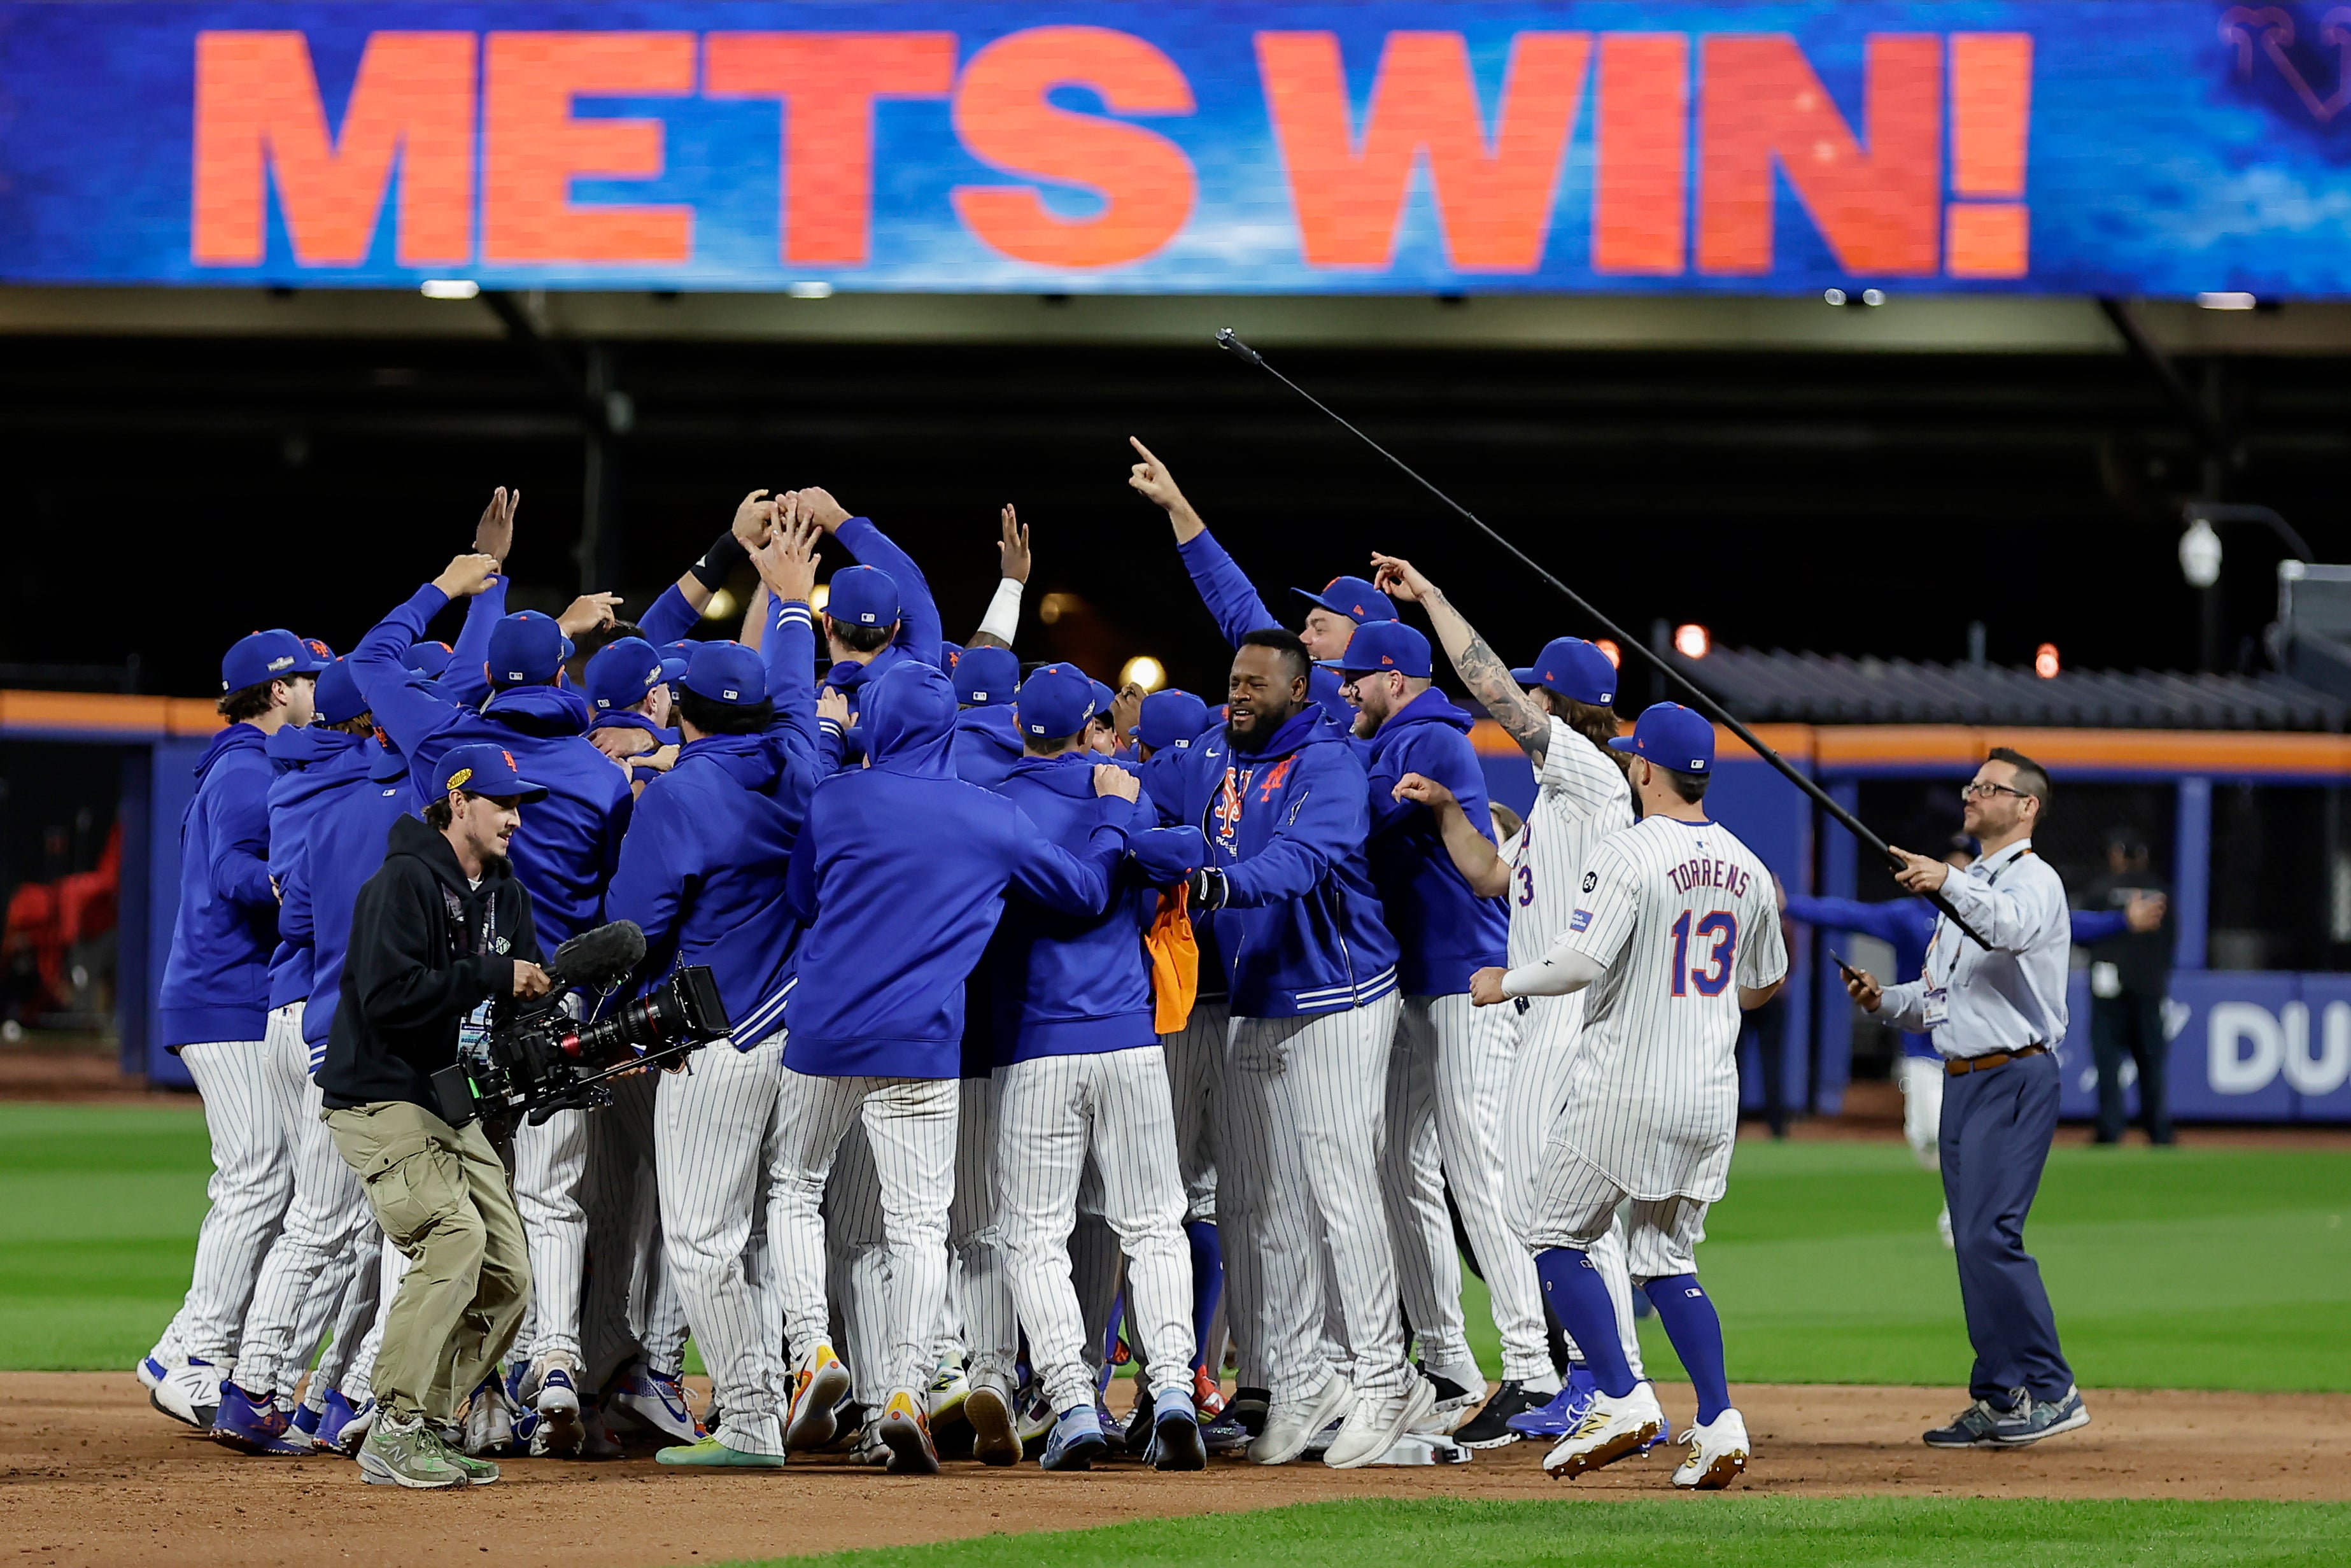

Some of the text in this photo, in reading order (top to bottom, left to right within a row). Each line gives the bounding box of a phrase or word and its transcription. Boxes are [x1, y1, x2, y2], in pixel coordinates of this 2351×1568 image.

[191, 25, 2033, 278] METS WIN!
[1583, 875, 1597, 890] 24
[1667, 859, 1751, 899] TORRENS
[1671, 909, 1739, 997] 13
